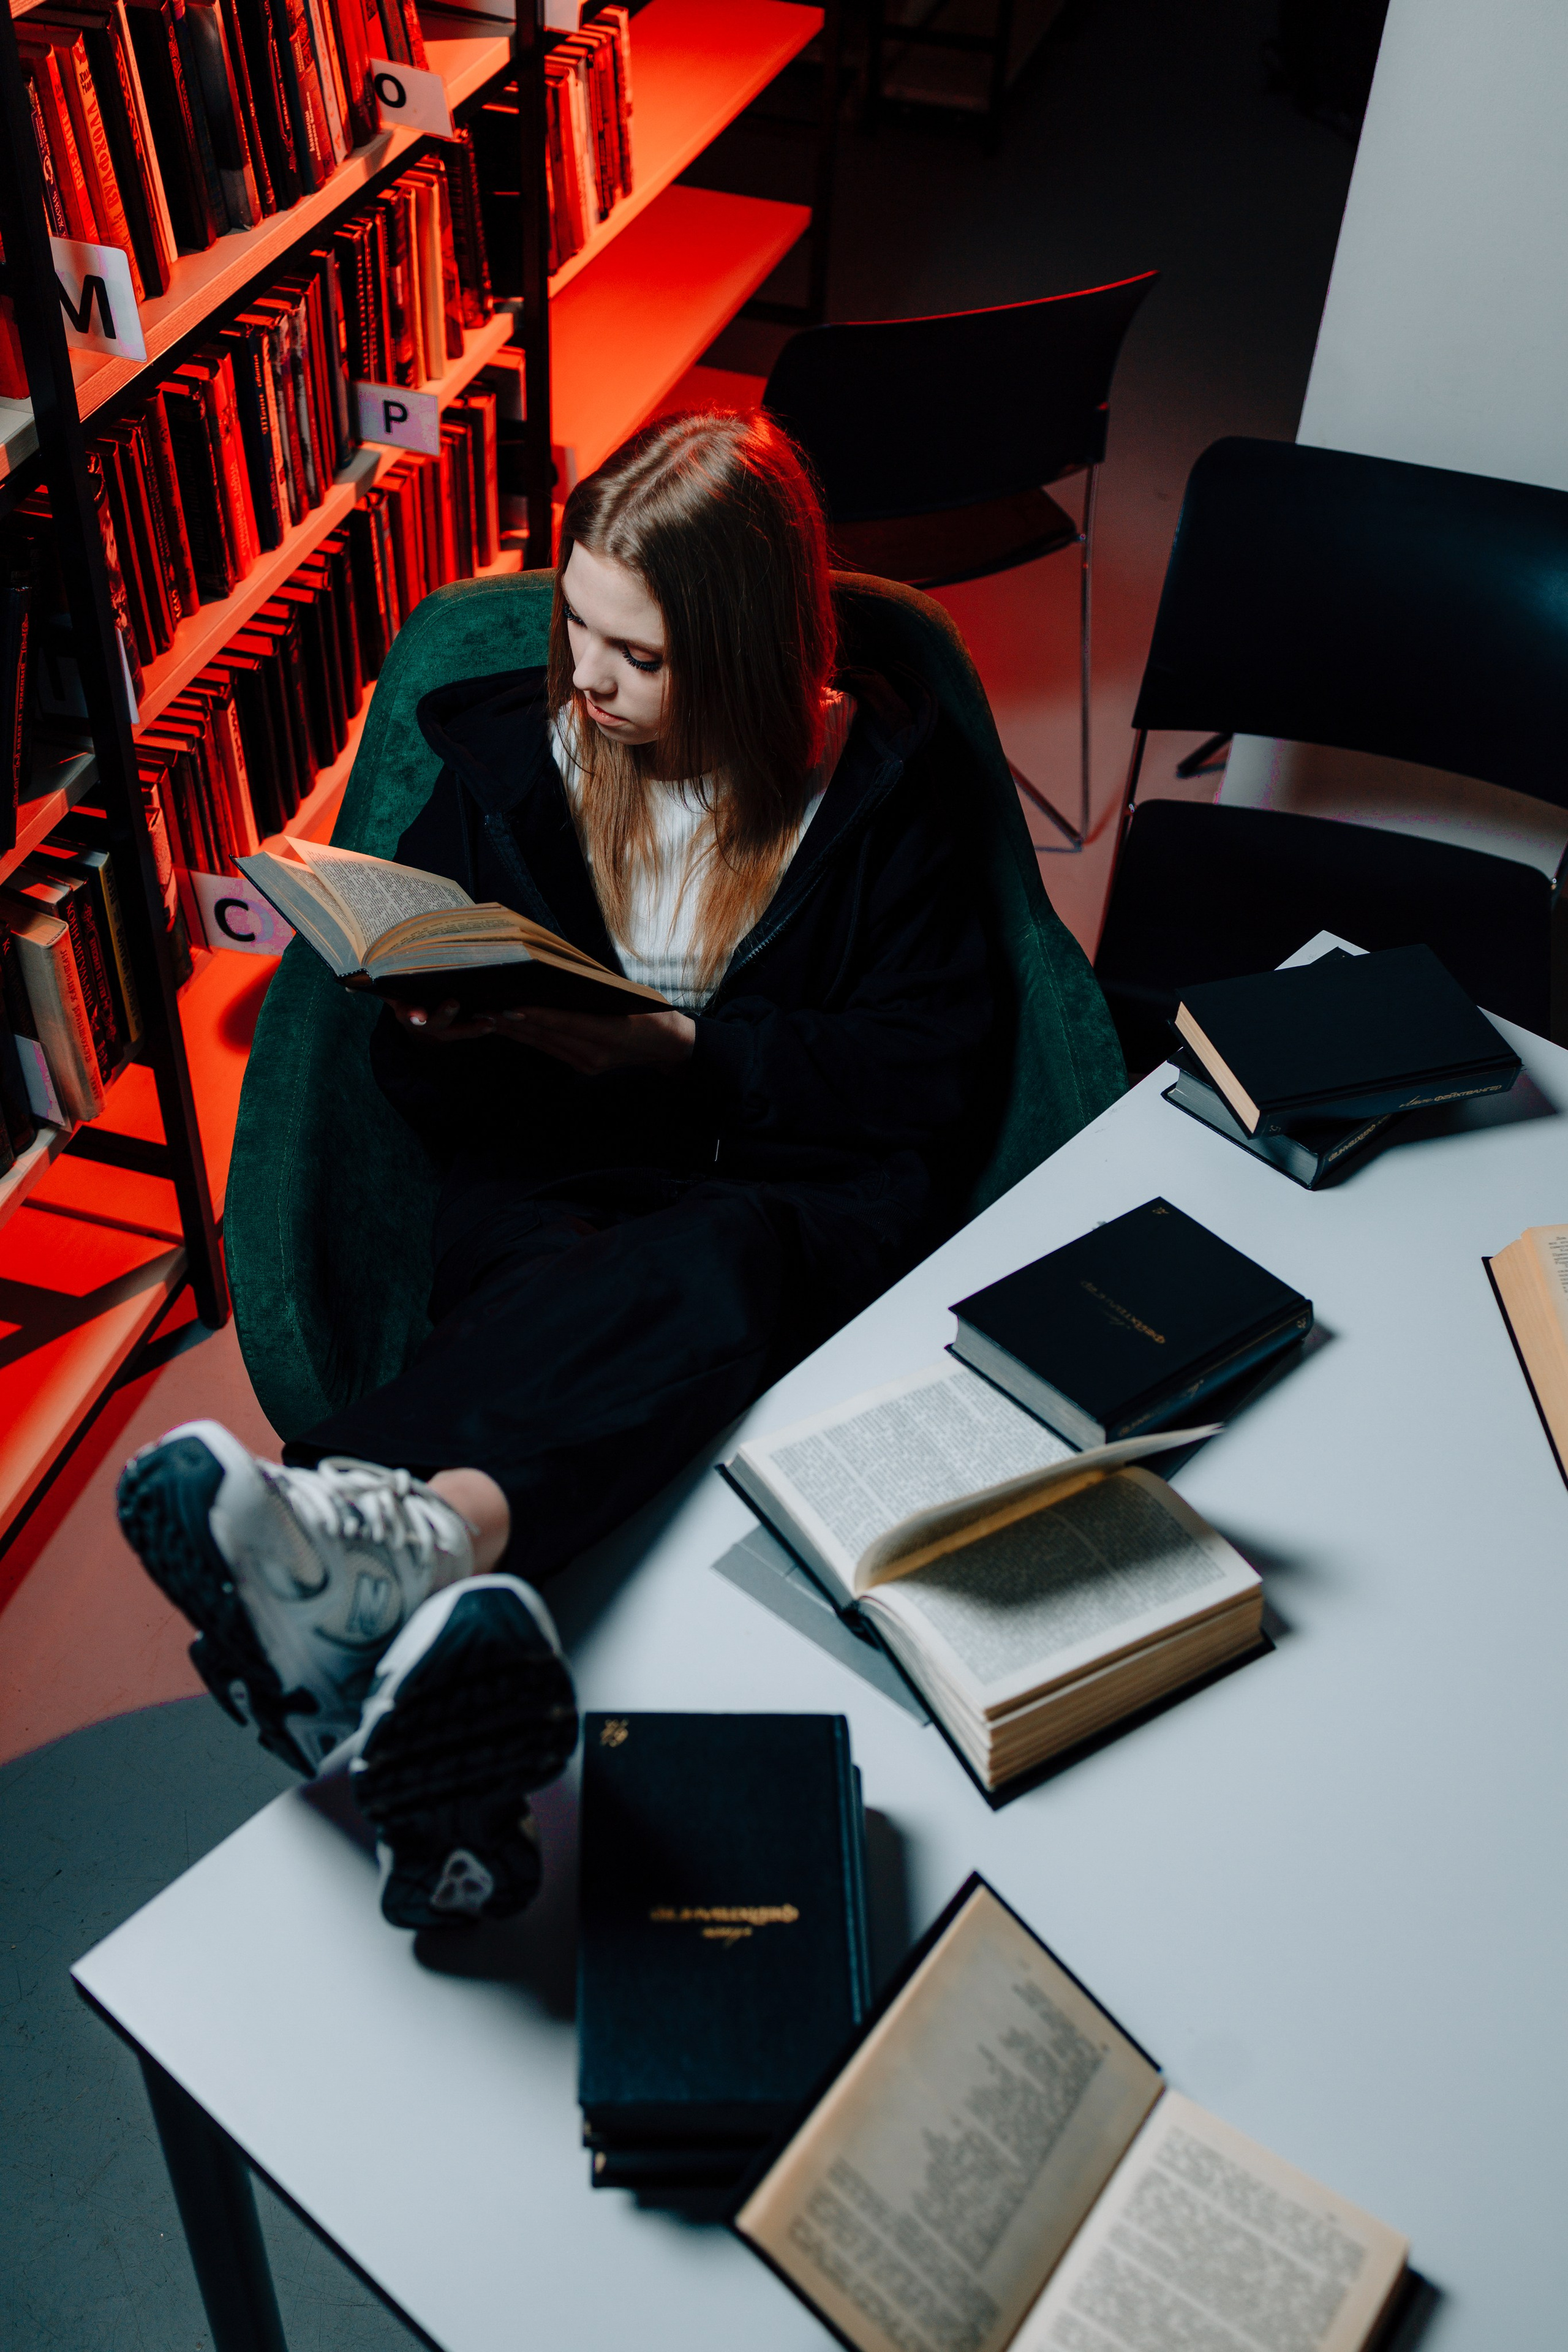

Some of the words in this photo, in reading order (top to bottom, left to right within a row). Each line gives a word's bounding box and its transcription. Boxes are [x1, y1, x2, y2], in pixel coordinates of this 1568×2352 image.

[51, 190, 65, 228] ЖИЗНЬ
[66, 900, 80, 941] КОНН
[60, 949, 78, 1003] КАПИТАН
[1434, 1085, 1502, 1102] ФЕЙХТВАНГЕР
